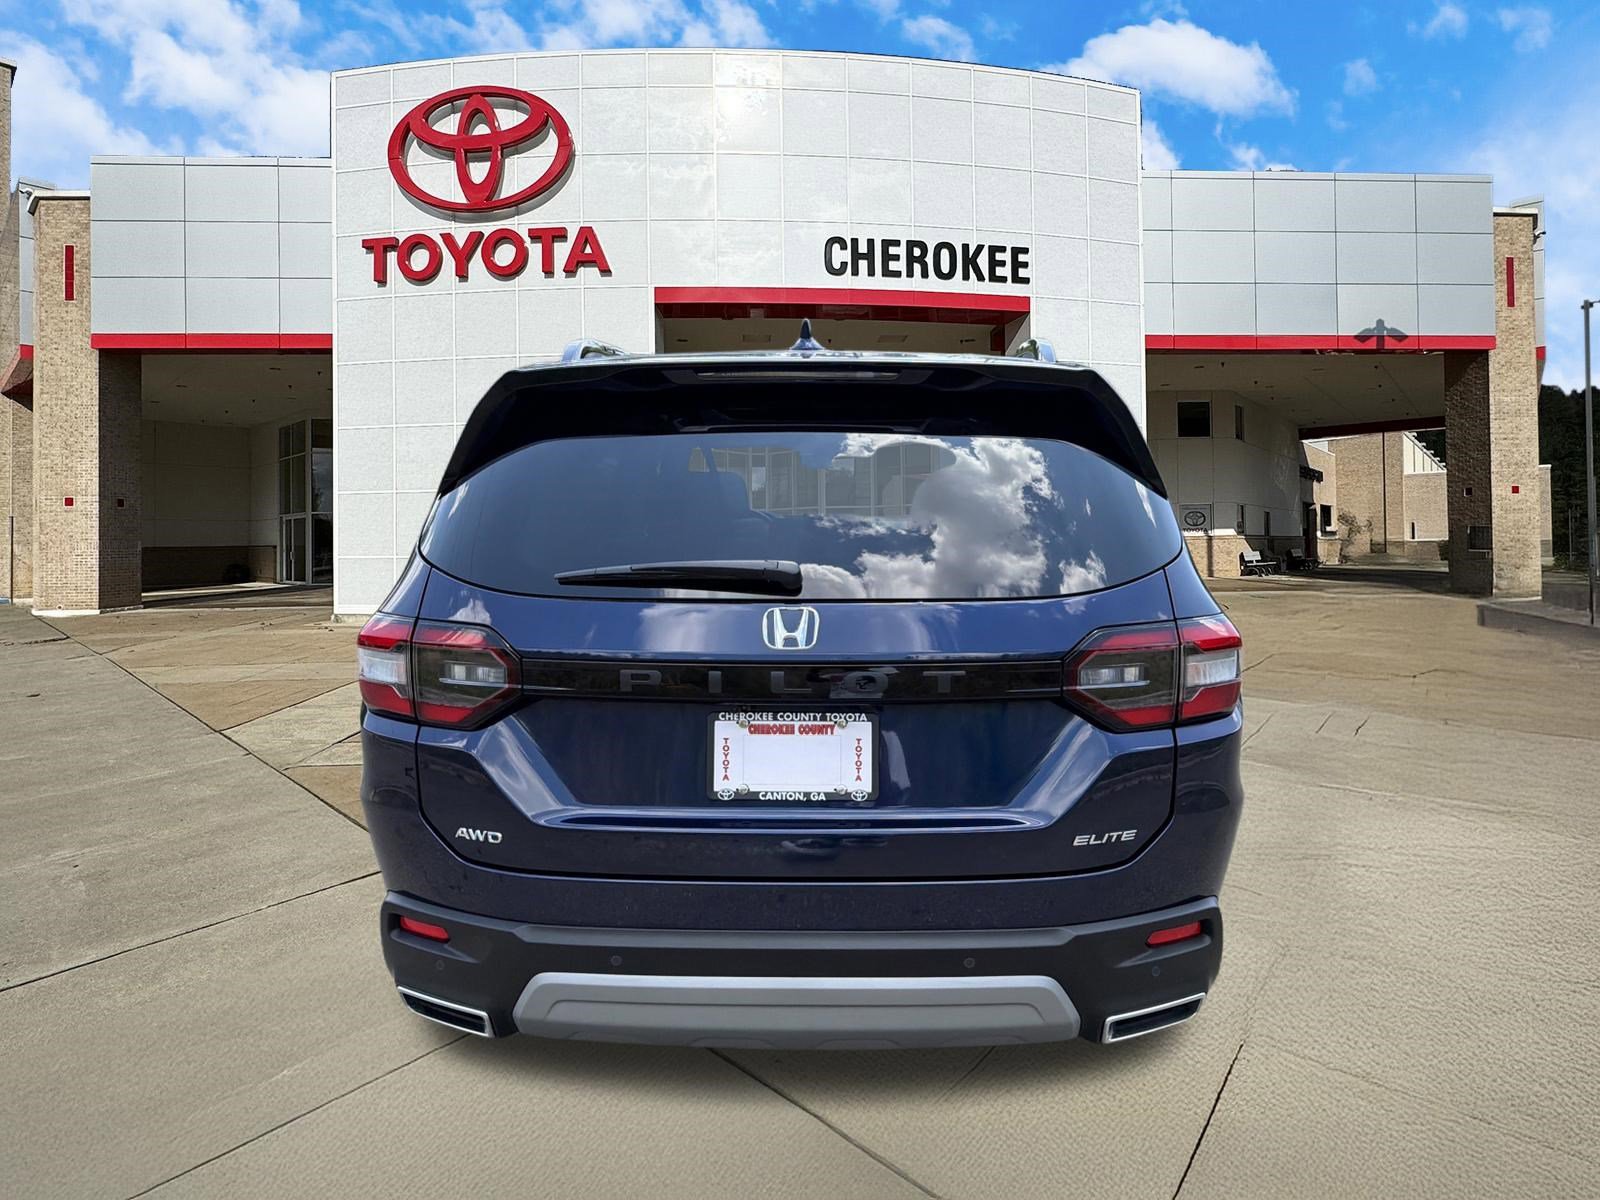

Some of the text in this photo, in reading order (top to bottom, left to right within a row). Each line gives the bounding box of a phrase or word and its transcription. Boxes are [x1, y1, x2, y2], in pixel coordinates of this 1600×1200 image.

[362, 226, 612, 287] TOYOTA
[824, 236, 1030, 284] CHEROKEE
[619, 668, 966, 694] PILOT
[718, 712, 868, 722] CHEROKEE COUNTY TOYOTA
[798, 724, 836, 735] COUNTY
[722, 738, 730, 781] TOYOTA
[854, 738, 863, 782] TOYOTA
[759, 791, 826, 801] CANTON, GA
[455, 827, 502, 844] AWD
[1072, 829, 1138, 846] ELITE
